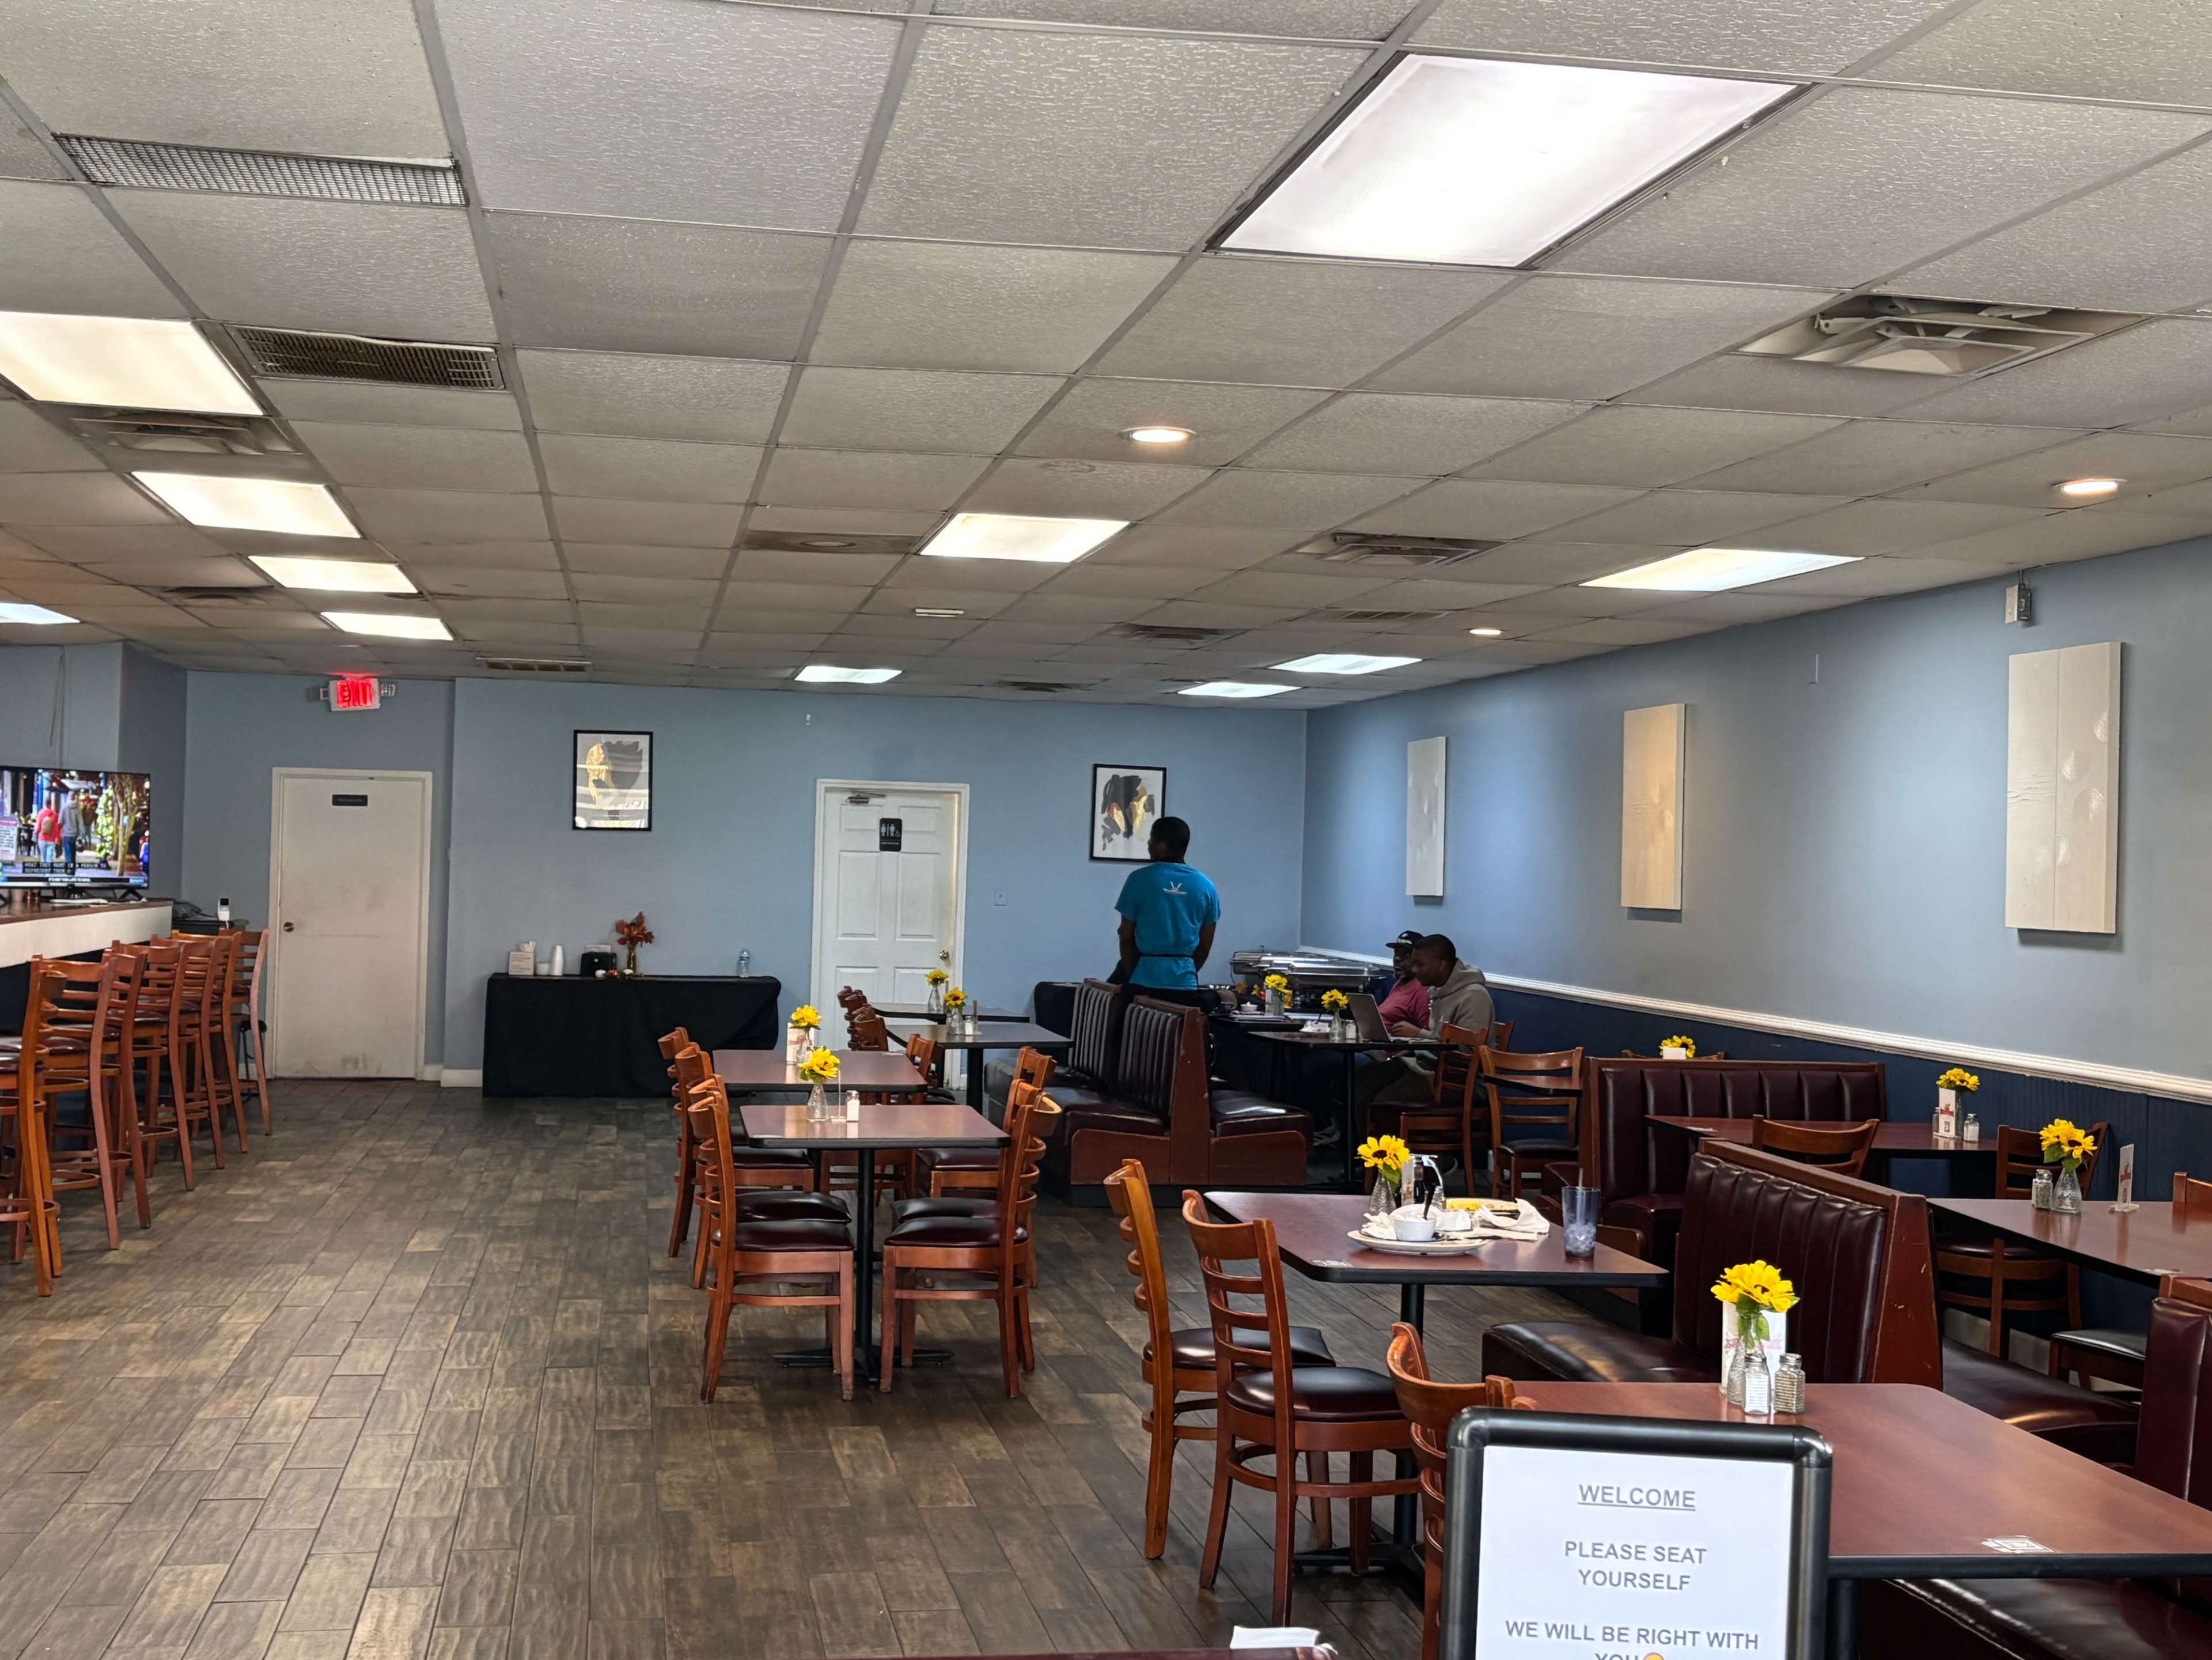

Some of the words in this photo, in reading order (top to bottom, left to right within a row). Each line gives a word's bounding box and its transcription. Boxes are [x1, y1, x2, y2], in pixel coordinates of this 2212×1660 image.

[1578, 1484, 1696, 1508] WELCOME
[1565, 1541, 1647, 1561] PLEASE
[1653, 1545, 1707, 1564] SEAT
[1578, 1569, 1691, 1591] YOURSELF
[1505, 1620, 1538, 1638] WE
[1544, 1622, 1594, 1641] WILL
[1602, 1626, 1630, 1643] BE
[1637, 1628, 1700, 1647] RIGHT
[1706, 1631, 1759, 1650] WITH
